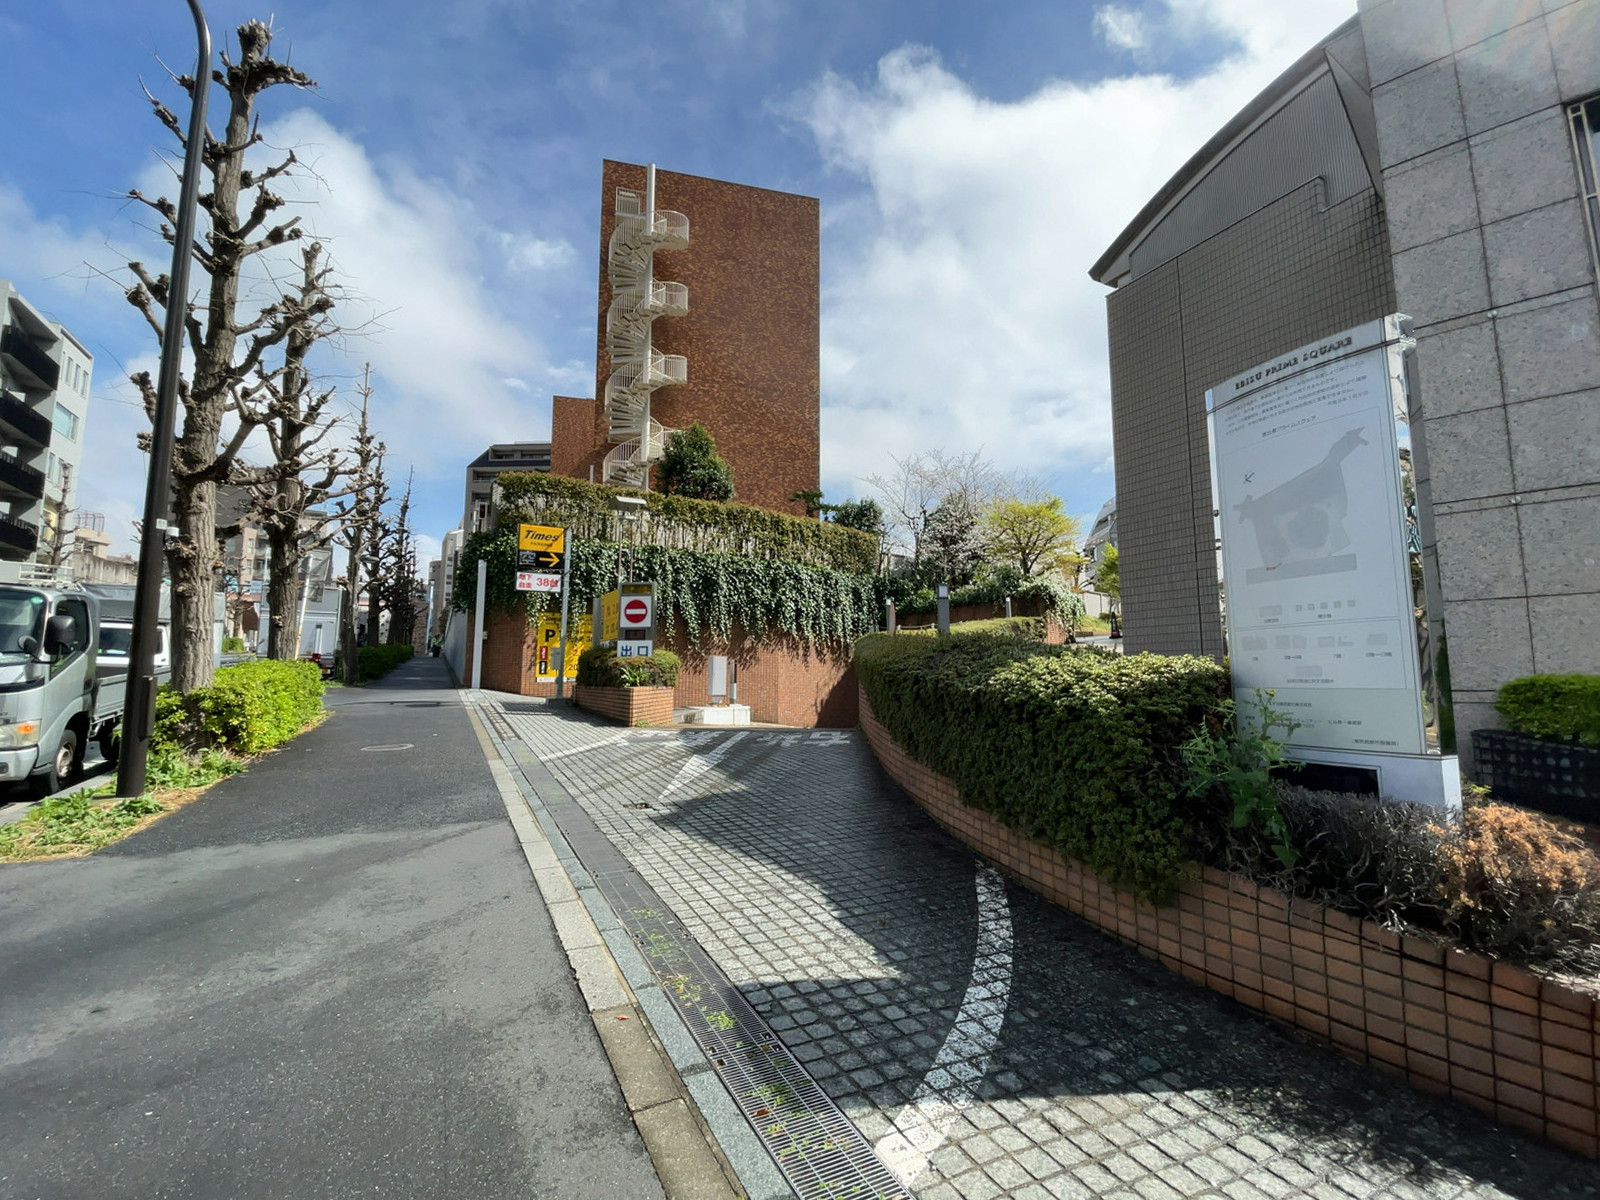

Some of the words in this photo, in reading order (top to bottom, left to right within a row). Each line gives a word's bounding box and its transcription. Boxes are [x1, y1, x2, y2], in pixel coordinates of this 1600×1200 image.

[1265, 357, 1299, 377] PRIME
[1302, 336, 1353, 361] SQUARE
[524, 530, 560, 542] Times
[545, 629, 556, 642] P
[621, 645, 649, 657] 出口
